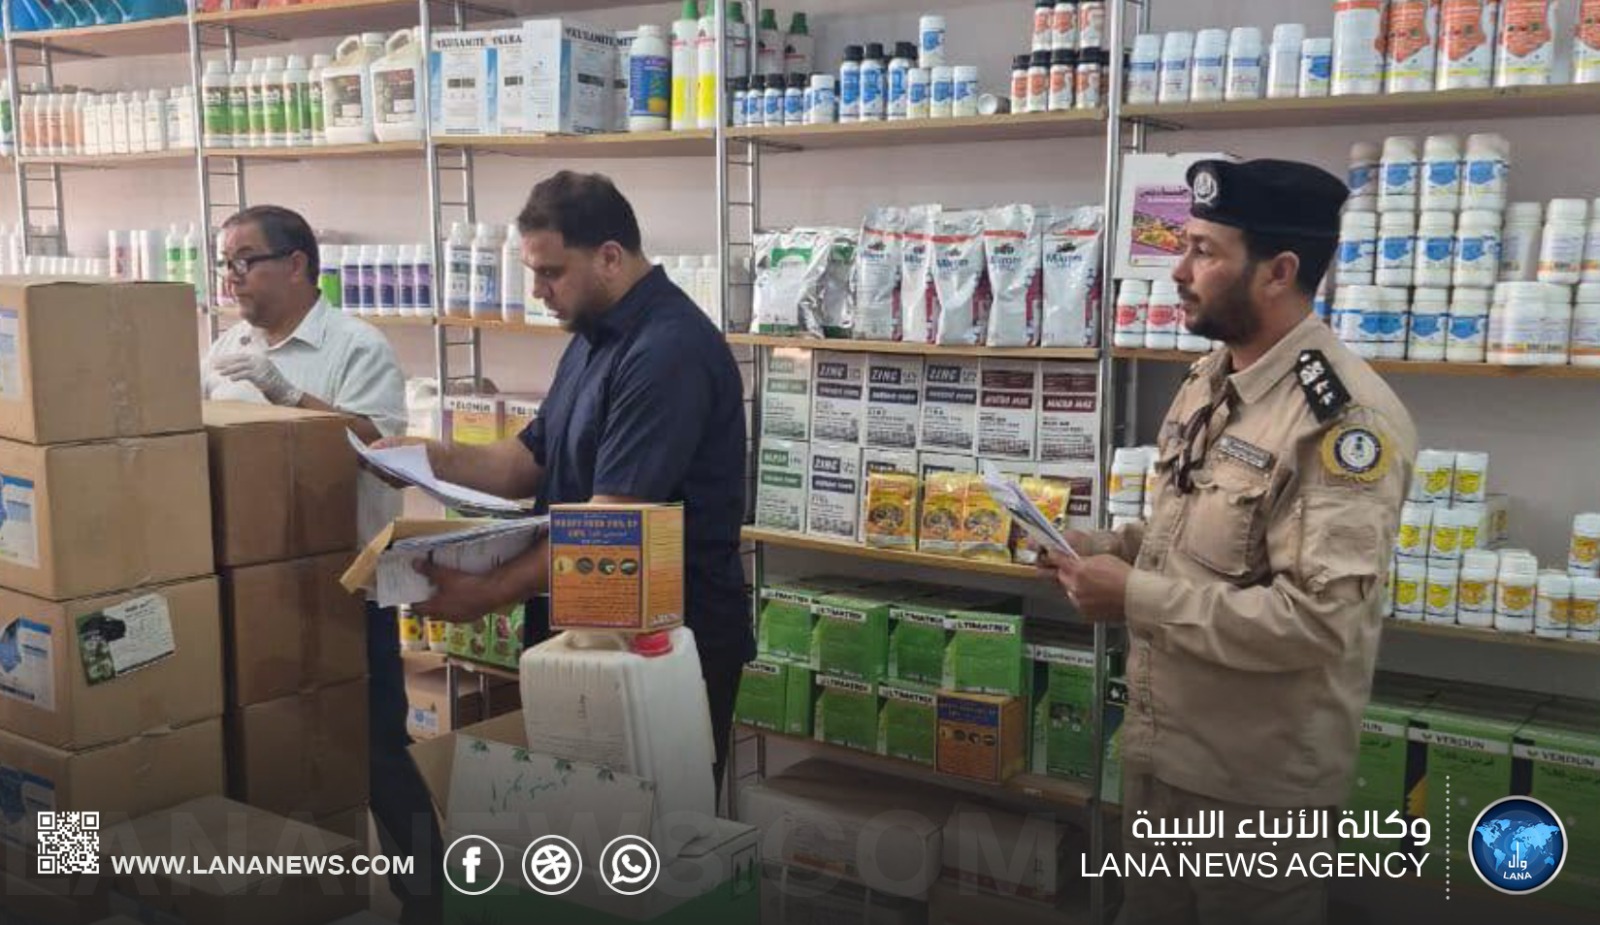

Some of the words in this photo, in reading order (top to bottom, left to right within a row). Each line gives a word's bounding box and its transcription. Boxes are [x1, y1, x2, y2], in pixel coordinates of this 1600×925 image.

[871, 369, 898, 382] ZINC
[1435, 735, 1485, 750] VERDUN
[1541, 751, 1596, 767] VERDUN
